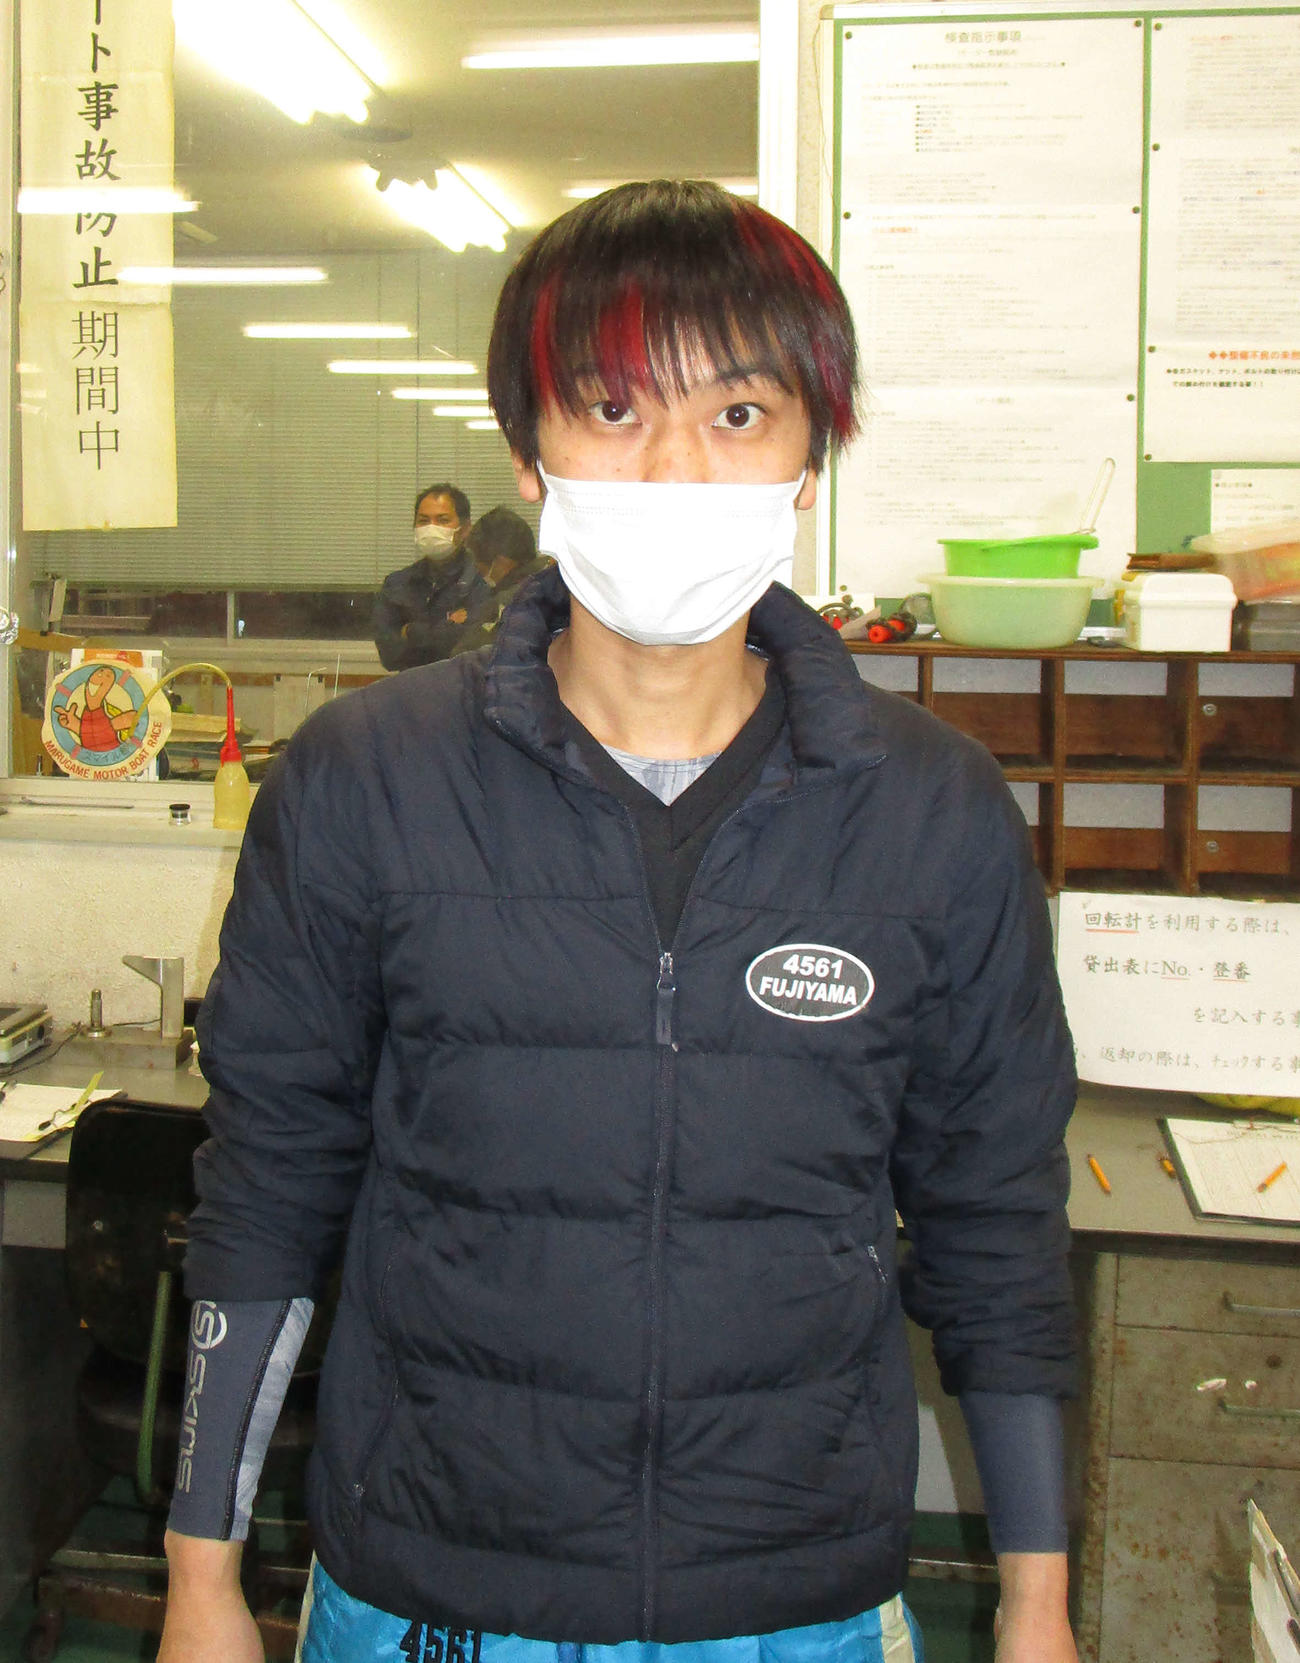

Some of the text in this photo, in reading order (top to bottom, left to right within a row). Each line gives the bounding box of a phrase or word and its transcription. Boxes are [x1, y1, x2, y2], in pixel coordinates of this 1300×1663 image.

[44, 721, 162, 779] MARUGAME MOTOR BOAT RACE
[1084, 911, 1290, 936] 回転計を利用する際は、
[782, 954, 844, 979] 4561
[759, 976, 858, 1005] FUJIYAMA
[400, 1618, 482, 1663] 4561
